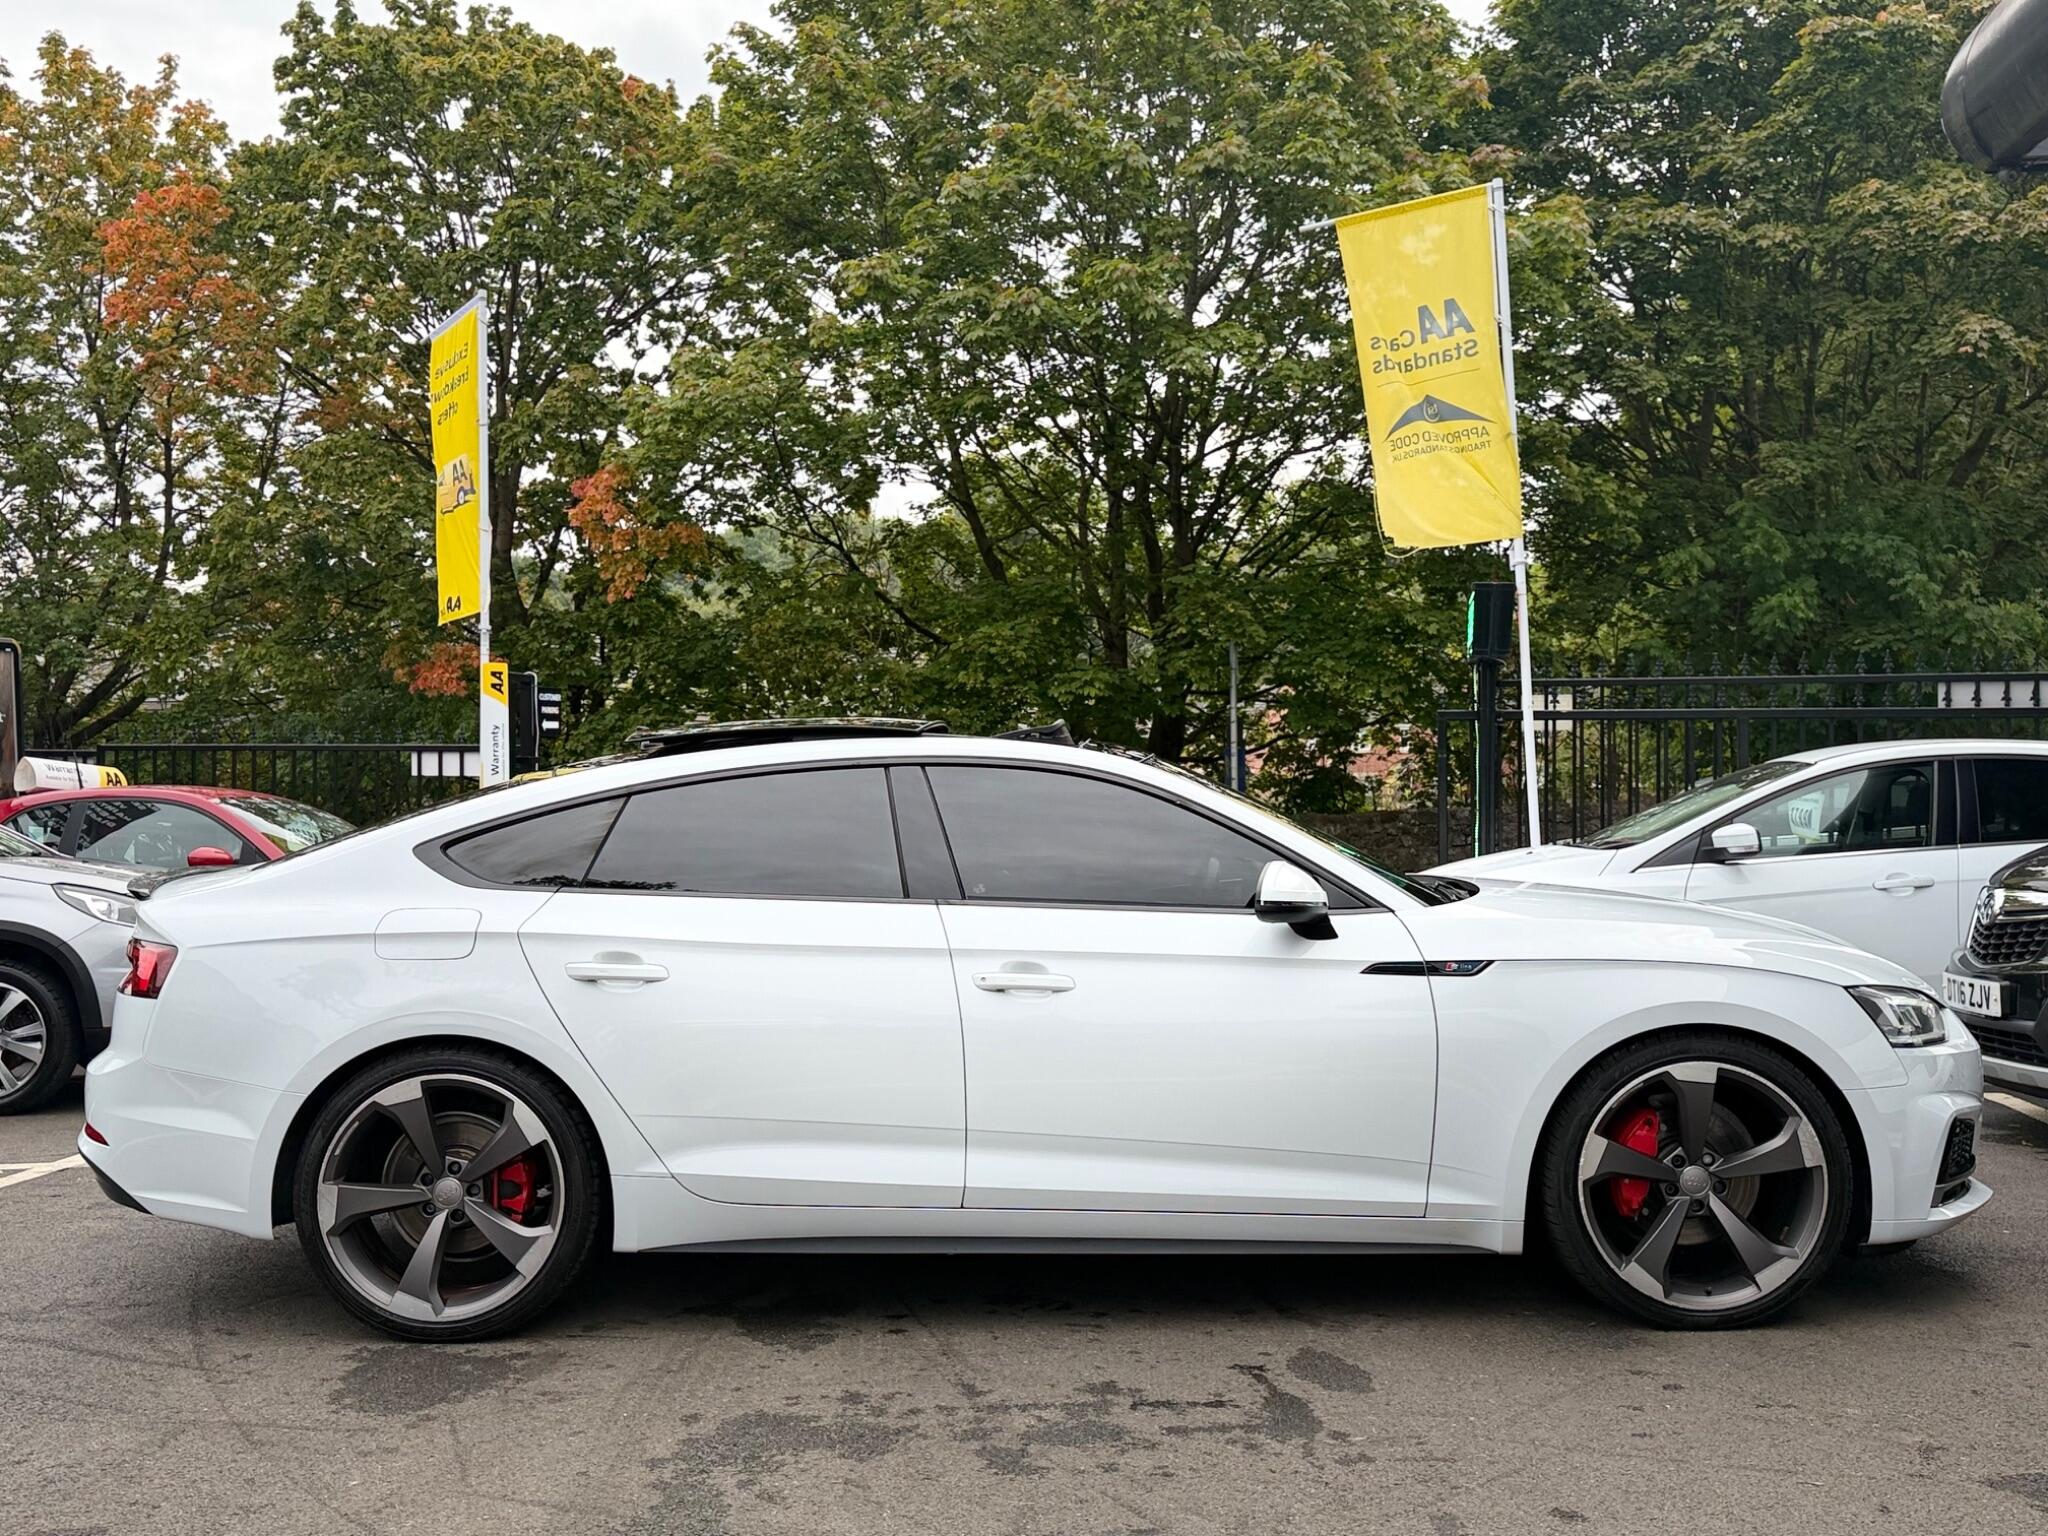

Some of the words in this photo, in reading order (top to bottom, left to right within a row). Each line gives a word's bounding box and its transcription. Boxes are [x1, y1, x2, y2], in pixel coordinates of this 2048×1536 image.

[490, 671, 504, 696] AA
[491, 724, 501, 776] Warranty
[105, 771, 122, 787] AA
[1968, 982, 1991, 1010] ZJV
